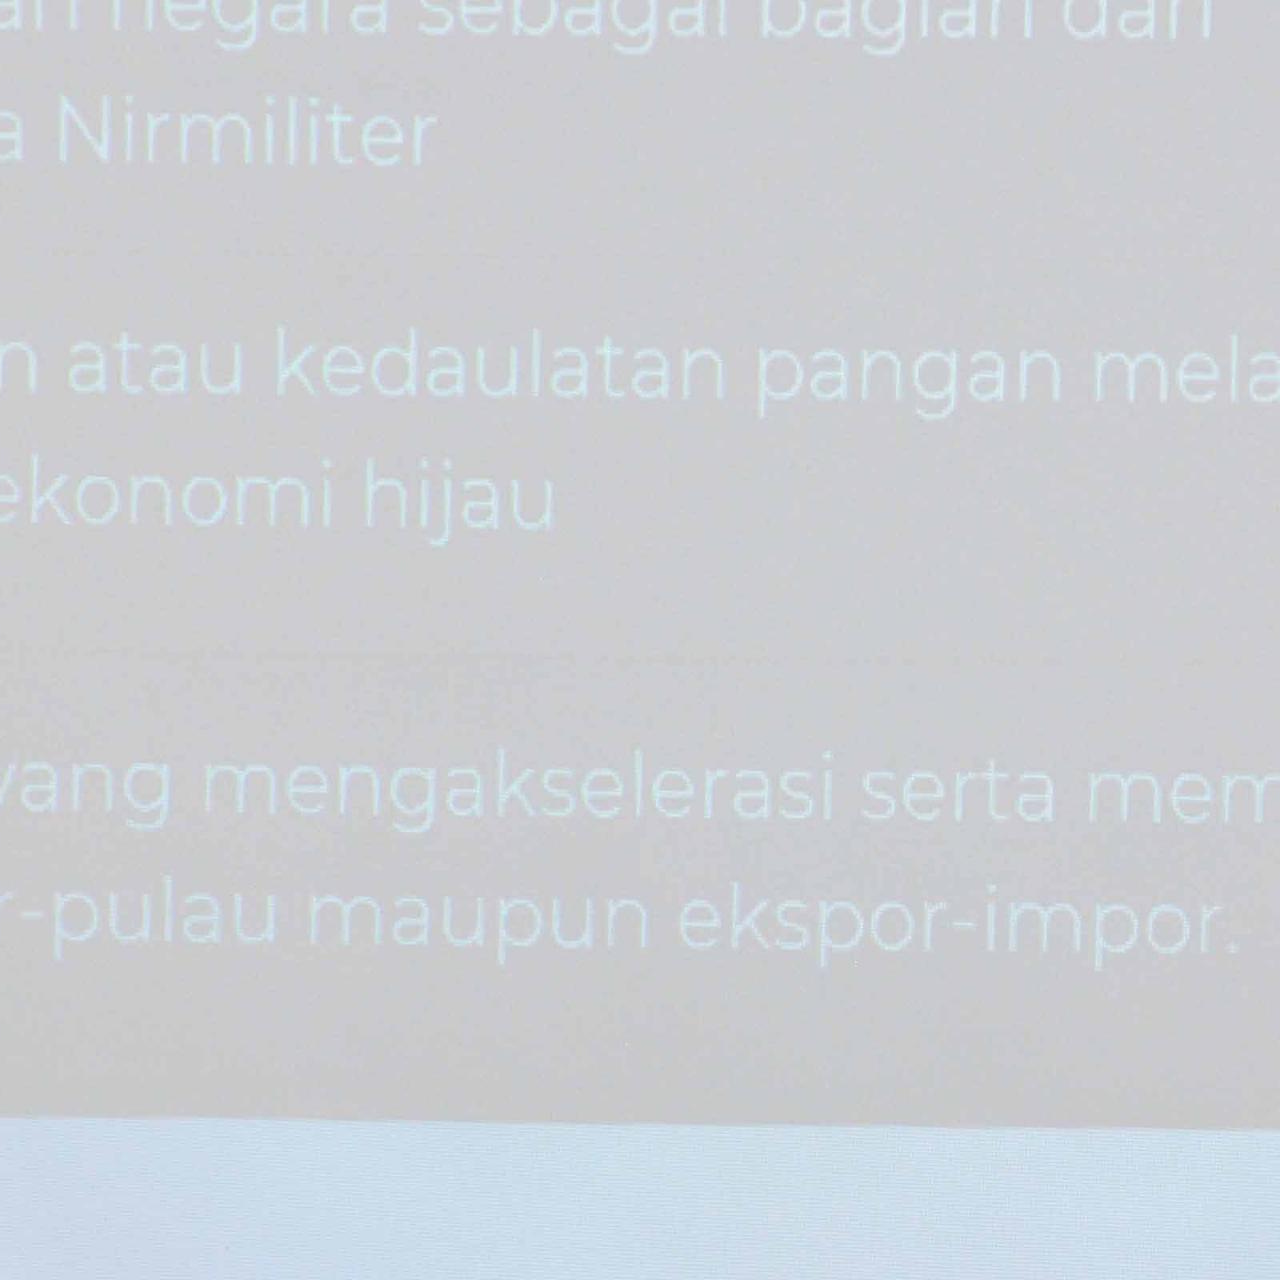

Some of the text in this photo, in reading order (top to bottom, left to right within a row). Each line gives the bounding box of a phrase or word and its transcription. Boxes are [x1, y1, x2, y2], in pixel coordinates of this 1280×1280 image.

[57, 94, 438, 169] Nirmiliter
[68, 333, 246, 399] atau
[273, 324, 728, 402] kedaulatan
[756, 345, 1064, 423] pangan
[363, 458, 558, 550] hijau
[203, 746, 834, 834] mengakselerasi
[860, 760, 1057, 824] serta
[307, 890, 651, 966] maupun
[678, 881, 1240, 971] ekspor-impor.
